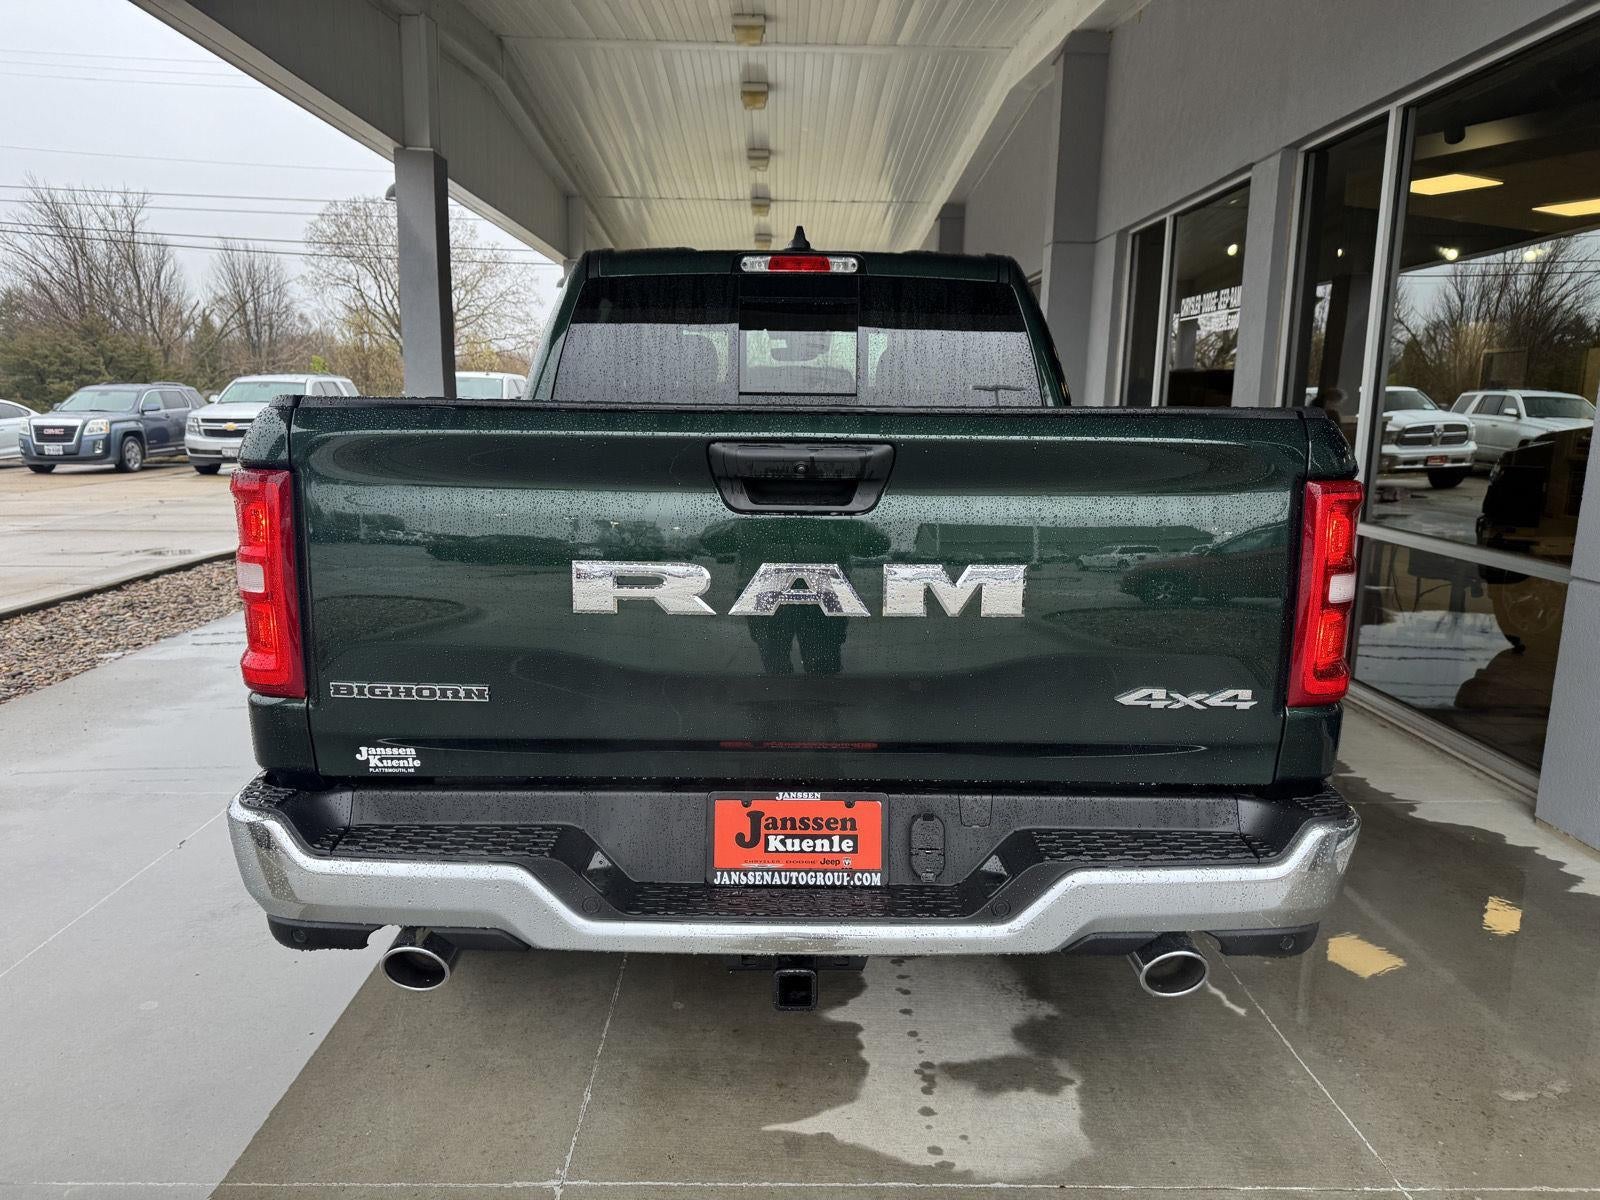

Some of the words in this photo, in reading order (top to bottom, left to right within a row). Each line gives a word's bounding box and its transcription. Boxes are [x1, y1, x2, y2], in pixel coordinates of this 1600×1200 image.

[572, 560, 1028, 618] RAM
[330, 682, 490, 702] BIGHORN
[355, 746, 416, 760] Janssen
[368, 755, 421, 767] Kuenle
[775, 792, 821, 800] JANSSEN
[735, 810, 858, 849] Janssen
[767, 835, 854, 852] Kuenle
[819, 857, 841, 866] Jeep
[713, 871, 882, 886] JANSSENAUTOGROUP.COM
